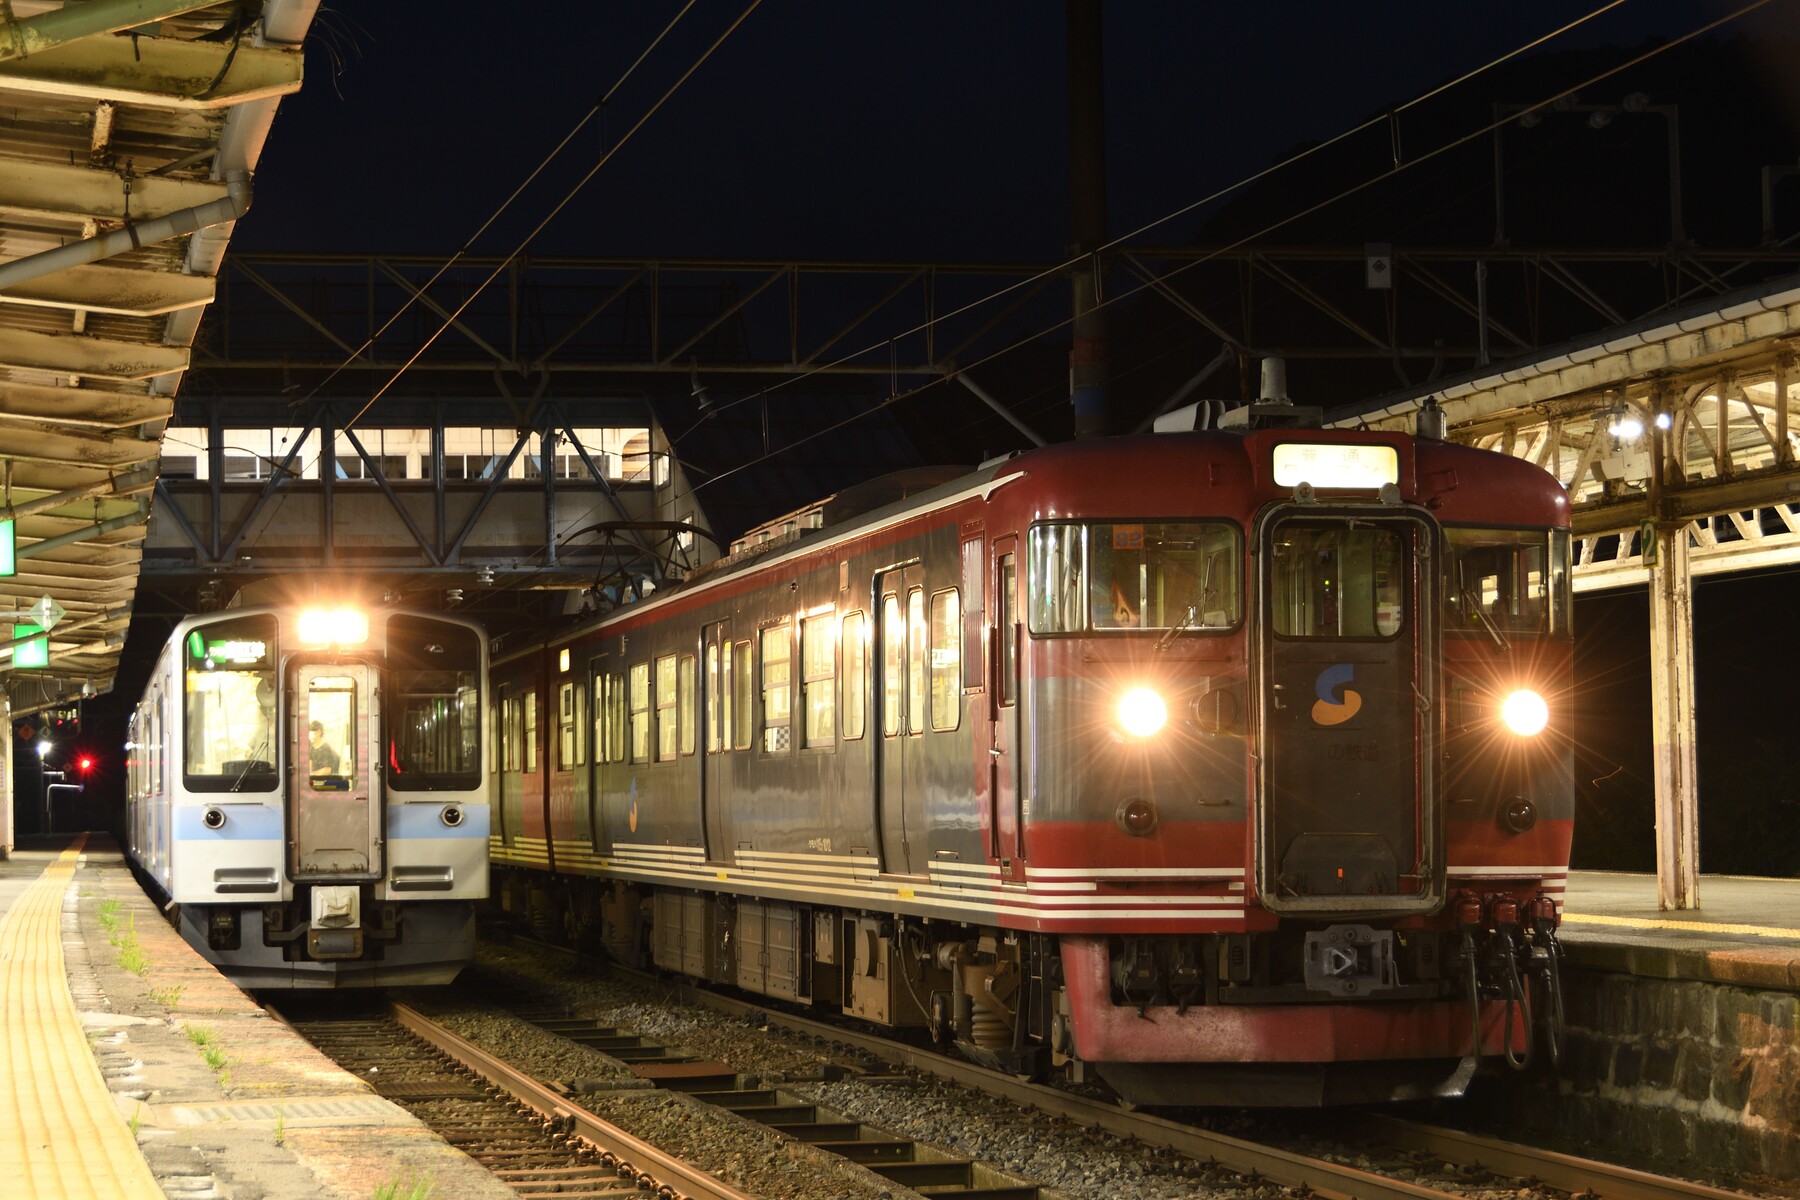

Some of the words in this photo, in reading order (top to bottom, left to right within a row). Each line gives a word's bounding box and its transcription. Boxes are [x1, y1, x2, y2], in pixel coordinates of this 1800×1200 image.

[1301, 448, 1360, 463] 普通
[1643, 523, 1656, 564] 2
[1319, 743, 1380, 761] の鉄道
